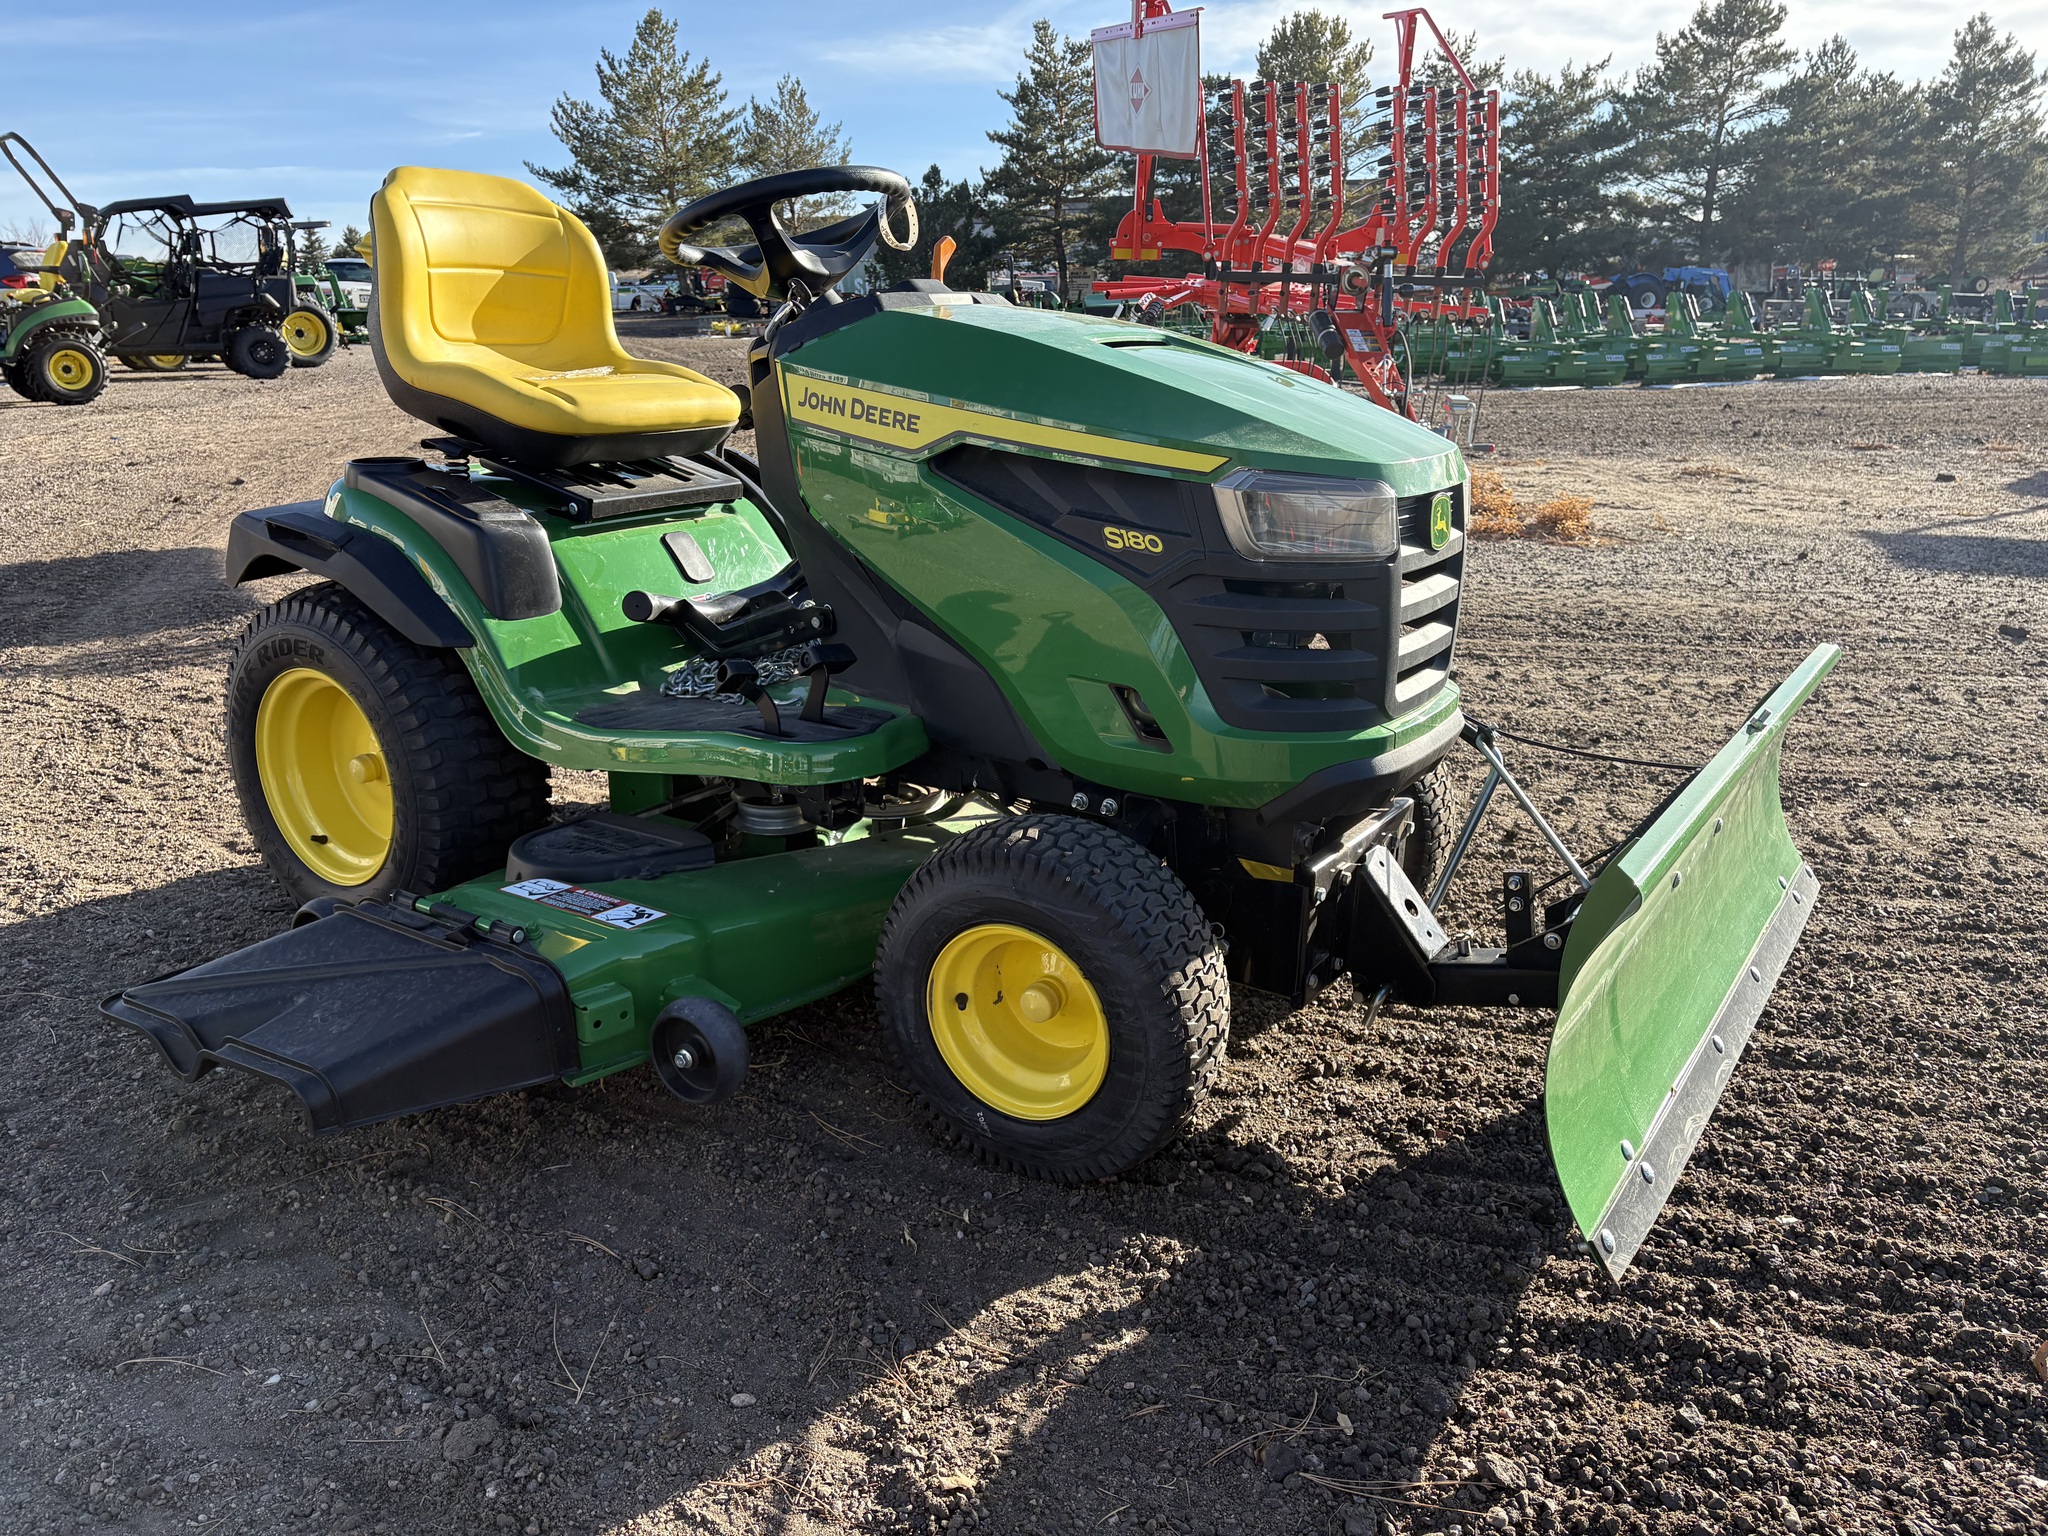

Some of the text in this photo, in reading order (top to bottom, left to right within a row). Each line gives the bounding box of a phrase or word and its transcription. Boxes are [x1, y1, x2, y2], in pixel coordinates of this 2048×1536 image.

[798, 386, 921, 434] JOHN DEERE
[1103, 526, 1163, 553] S180
[257, 638, 325, 667] RIDER
